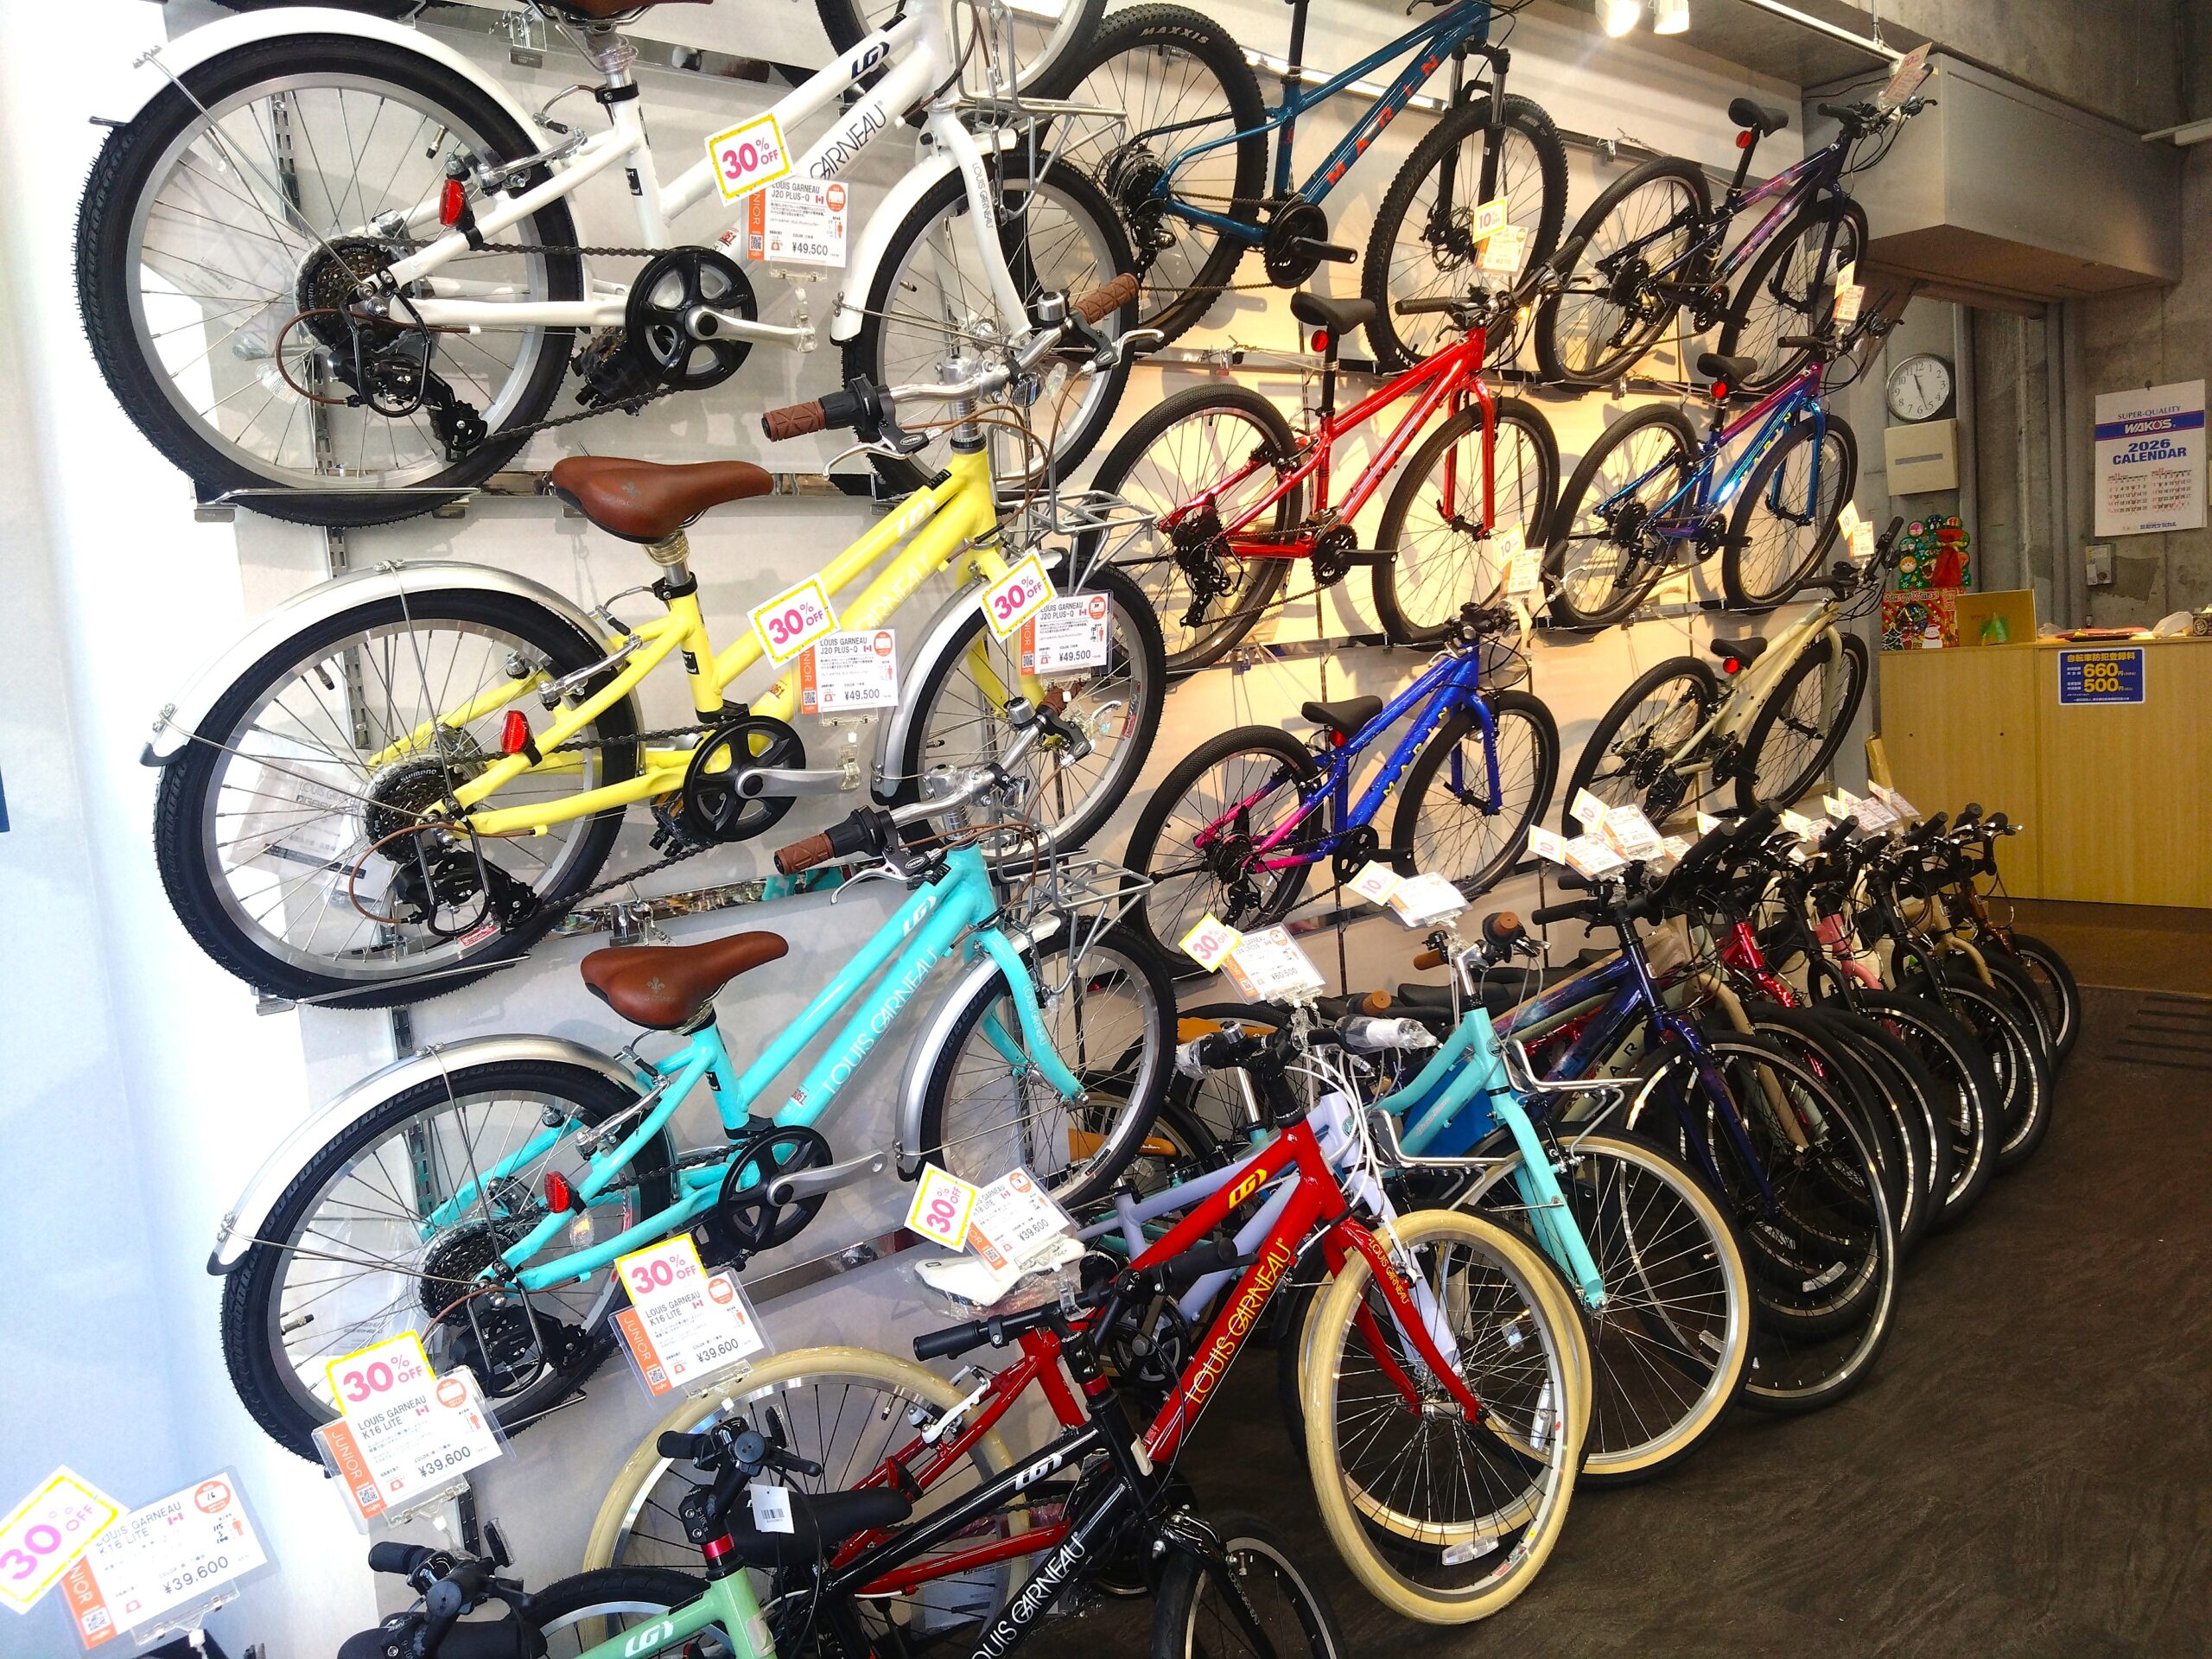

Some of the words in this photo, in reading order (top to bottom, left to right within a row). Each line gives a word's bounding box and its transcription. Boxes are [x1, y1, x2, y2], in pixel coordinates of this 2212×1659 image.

[1140, 26, 1210, 44] MAXXIS
[810, 103, 887, 180] GARNEAU
[722, 143, 758, 180] 30
[760, 149, 779, 165] OFF
[771, 191, 785, 200] J20
[785, 192, 810, 202] PLUS-Q
[772, 181, 790, 192] LOUIS
[791, 182, 820, 194] GARNEAU
[972, 162, 986, 189] LOUIS
[980, 190, 994, 229] GARNEAU
[752, 192, 761, 226] NIOR
[1906, 367, 1913, 376] 11
[1915, 362, 1923, 372] 12
[1936, 370, 1942, 378] 2
[1897, 376, 1906, 385] 10
[1941, 380, 1946, 390] 3
[1898, 398, 1904, 407] 8
[1929, 401, 1934, 410] 5
[1936, 392, 1941, 401] 4
[1908, 404, 1913, 413] 7
[1917, 405, 1923, 415] 6
[2118, 406, 2181, 421] SUPER-QUALITY
[2113, 448, 2187, 465] CALENDAR
[2128, 439, 2171, 453] 2026
[995, 585, 1026, 620] 30
[1021, 575, 1033, 588] %
[1027, 582, 1042, 598] OFF
[1052, 611, 1075, 620] PLUS-Q
[1058, 601, 1084, 611] GARNEAU
[769, 609, 804, 645] 30
[800, 601, 814, 614] %
[806, 610, 823, 626] OFF
[820, 638, 838, 647] LOUIS
[840, 637, 868, 646] GARNEAU
[820, 647, 833, 656] J20
[835, 645, 858, 655] PLUS-Q
[803, 650, 812, 683] NIOR
[1383, 707, 1449, 797] MARIN
[400, 769, 437, 783] SHIMANO
[1192, 935, 1219, 960] 30
[823, 1033, 874, 1094] LOUIS
[870, 947, 938, 1034] GARNEAU
[950, 1186, 962, 1204] OFF
[983, 1185, 1006, 1203] GARNEAU
[926, 1199, 956, 1233] 30
[632, 1260, 673, 1294] 30
[669, 1254, 686, 1268] %
[677, 1265, 696, 1280] OFF
[1369, 1239, 1389, 1268] LOUIS
[1386, 1266, 1410, 1305] GARNEAU
[645, 1304, 668, 1319] LOUIS
[668, 1291, 701, 1309] GARNEAU
[649, 1315, 665, 1326] K16
[666, 1309, 682, 1321] LITE
[1185, 1336, 1236, 1405] LOUIS
[1228, 1242, 1291, 1337] GARNEAU
[624, 1318, 652, 1362] JUNIOR
[696, 1338, 739, 1363] ¥39,600
[343, 1362, 394, 1402] 30
[391, 1354, 410, 1370] %
[397, 1366, 423, 1382] OFF
[358, 1414, 385, 1431] LOUIS
[386, 1395, 427, 1417] GARNEAU
[362, 1427, 382, 1440] K16
[385, 1416, 404, 1431] LITE
[332, 1432, 363, 1480] JUNIOR
[417, 1446, 471, 1477] ¥39,600
[66, 1504, 94, 1532] OFF
[131, 1501, 181, 1530] GARNEAU
[0, 1524, 62, 1580] 30
[99, 1541, 123, 1556] K16
[128, 1529, 150, 1546] LITE
[70, 1564, 93, 1604] NIOR
[162, 1555, 229, 1594] ¥39,600
[1011, 1535, 1086, 1624] GARNEAU
